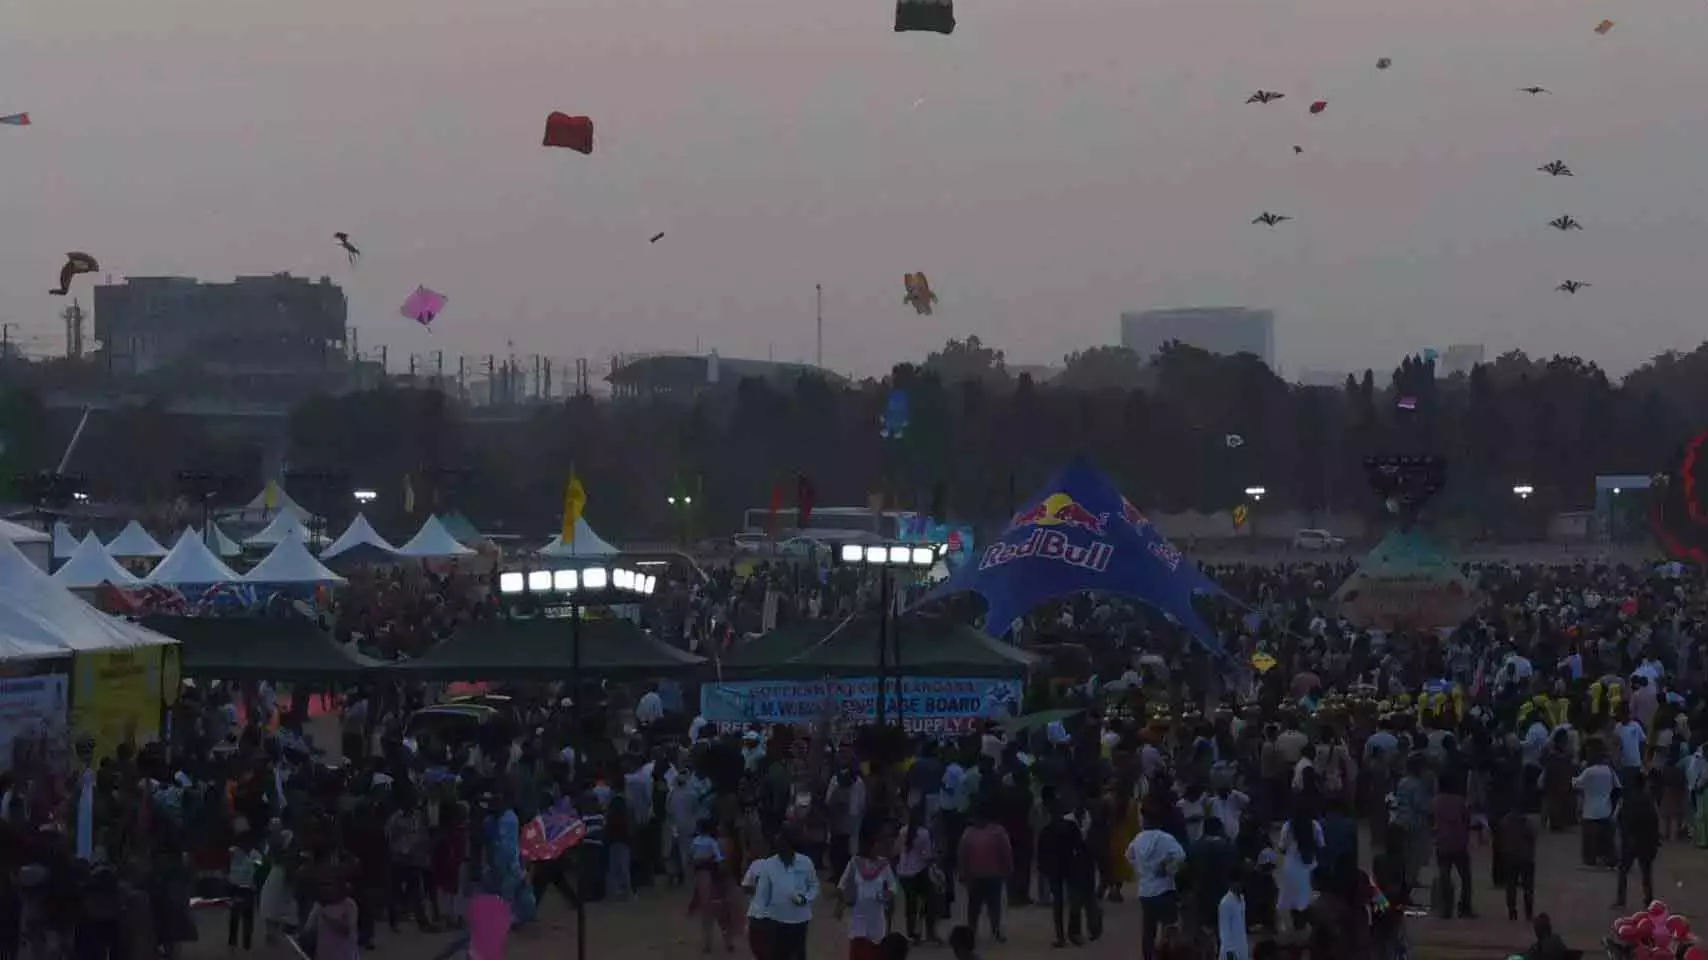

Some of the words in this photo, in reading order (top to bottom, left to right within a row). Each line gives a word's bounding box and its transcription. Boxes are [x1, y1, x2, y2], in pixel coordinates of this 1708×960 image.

[979, 528, 1043, 570] Red
[1035, 529, 1115, 573] Bull
[925, 696, 982, 714] BOARD
[903, 718, 965, 733] SUPPLY
